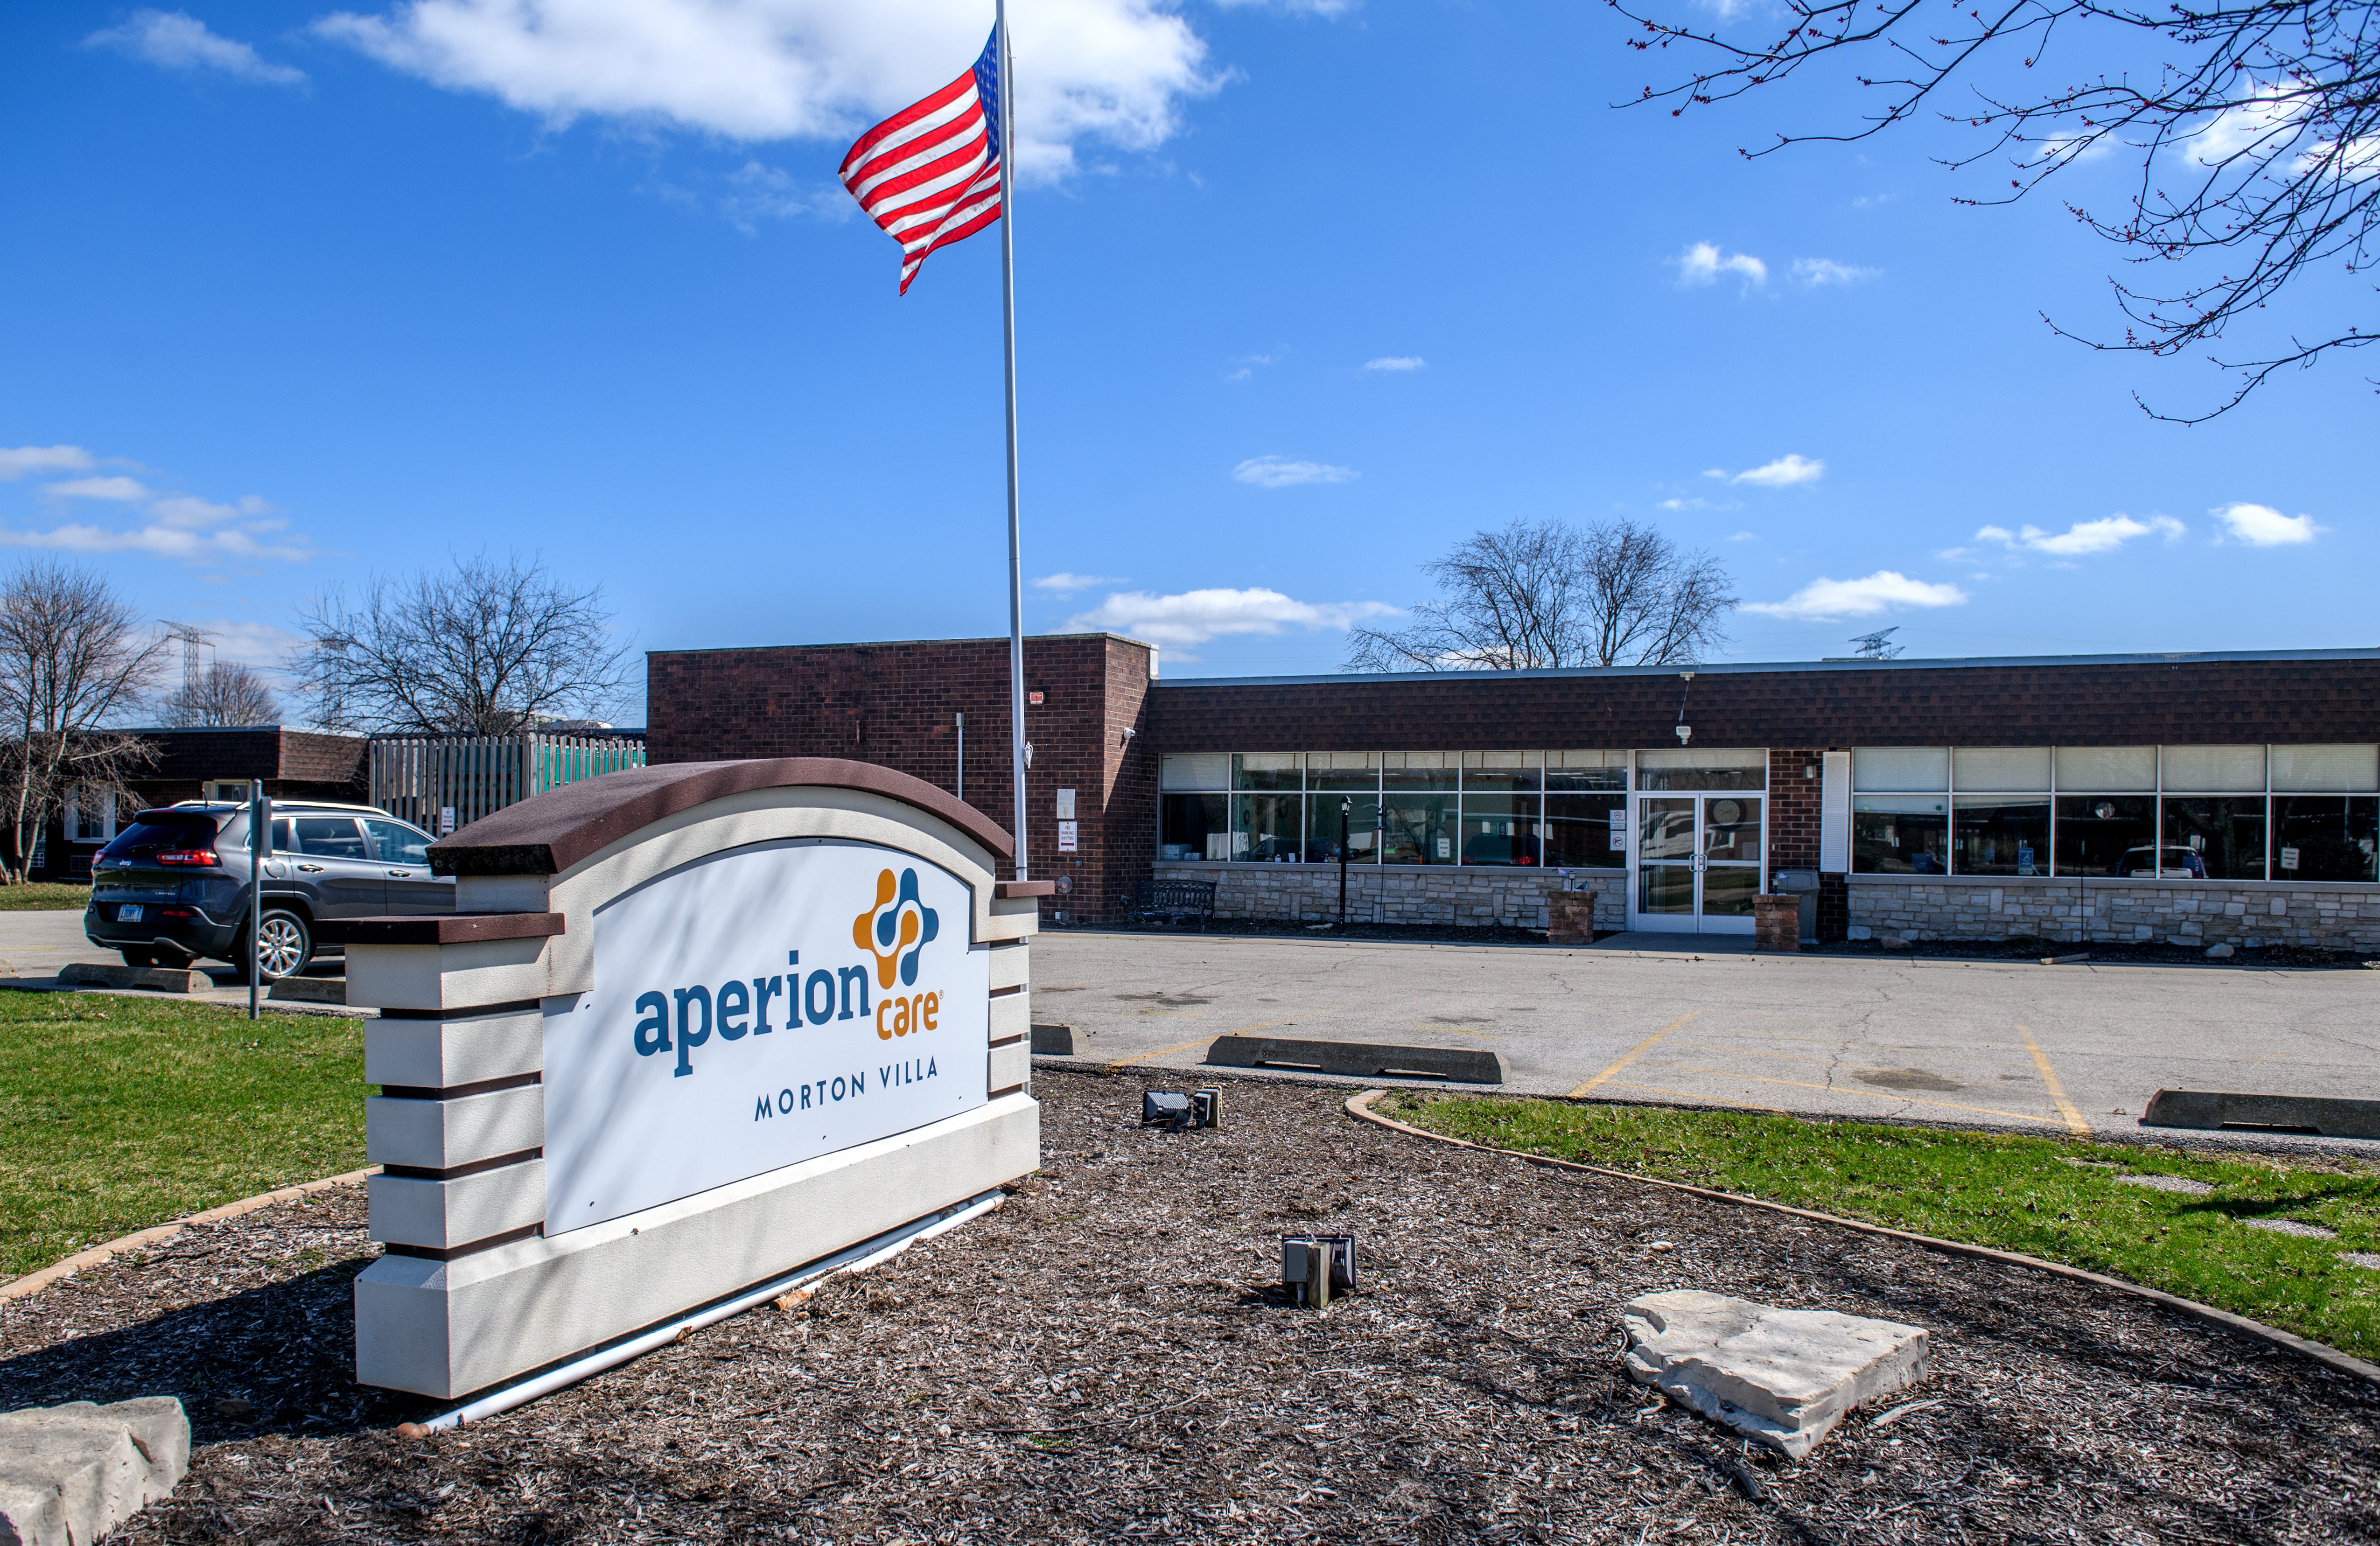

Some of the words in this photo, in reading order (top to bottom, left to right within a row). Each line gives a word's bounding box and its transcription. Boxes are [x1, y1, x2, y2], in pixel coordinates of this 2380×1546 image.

[634, 950, 871, 1078] aperion
[754, 1071, 865, 1122] MORTON
[879, 1056, 938, 1089] VILLA
